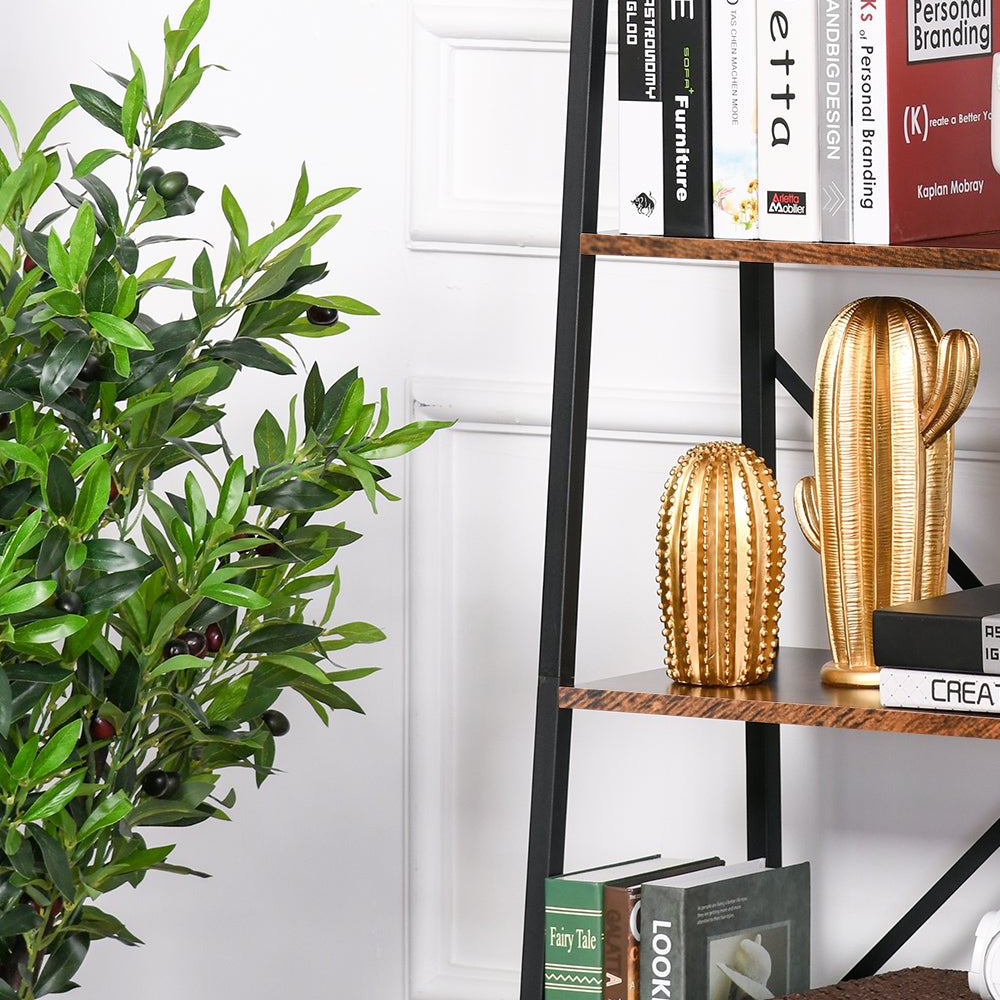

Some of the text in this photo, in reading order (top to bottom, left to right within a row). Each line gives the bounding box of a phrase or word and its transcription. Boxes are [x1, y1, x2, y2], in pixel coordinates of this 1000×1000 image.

[859, 29, 867, 40] of
[914, 20, 990, 51] Branding
[861, 46, 875, 122] Personal
[731, 98, 739, 126] MODE
[951, 116, 957, 125] a
[959, 113, 981, 123] Better
[983, 110, 992, 121] Yo
[674, 95, 690, 202] Furniture
[860, 129, 876, 209] Branding
[917, 179, 984, 200] Kaplan Mobray
[550, 926, 597, 953] Fairy Tale
[652, 920, 672, 1000] LOOK
